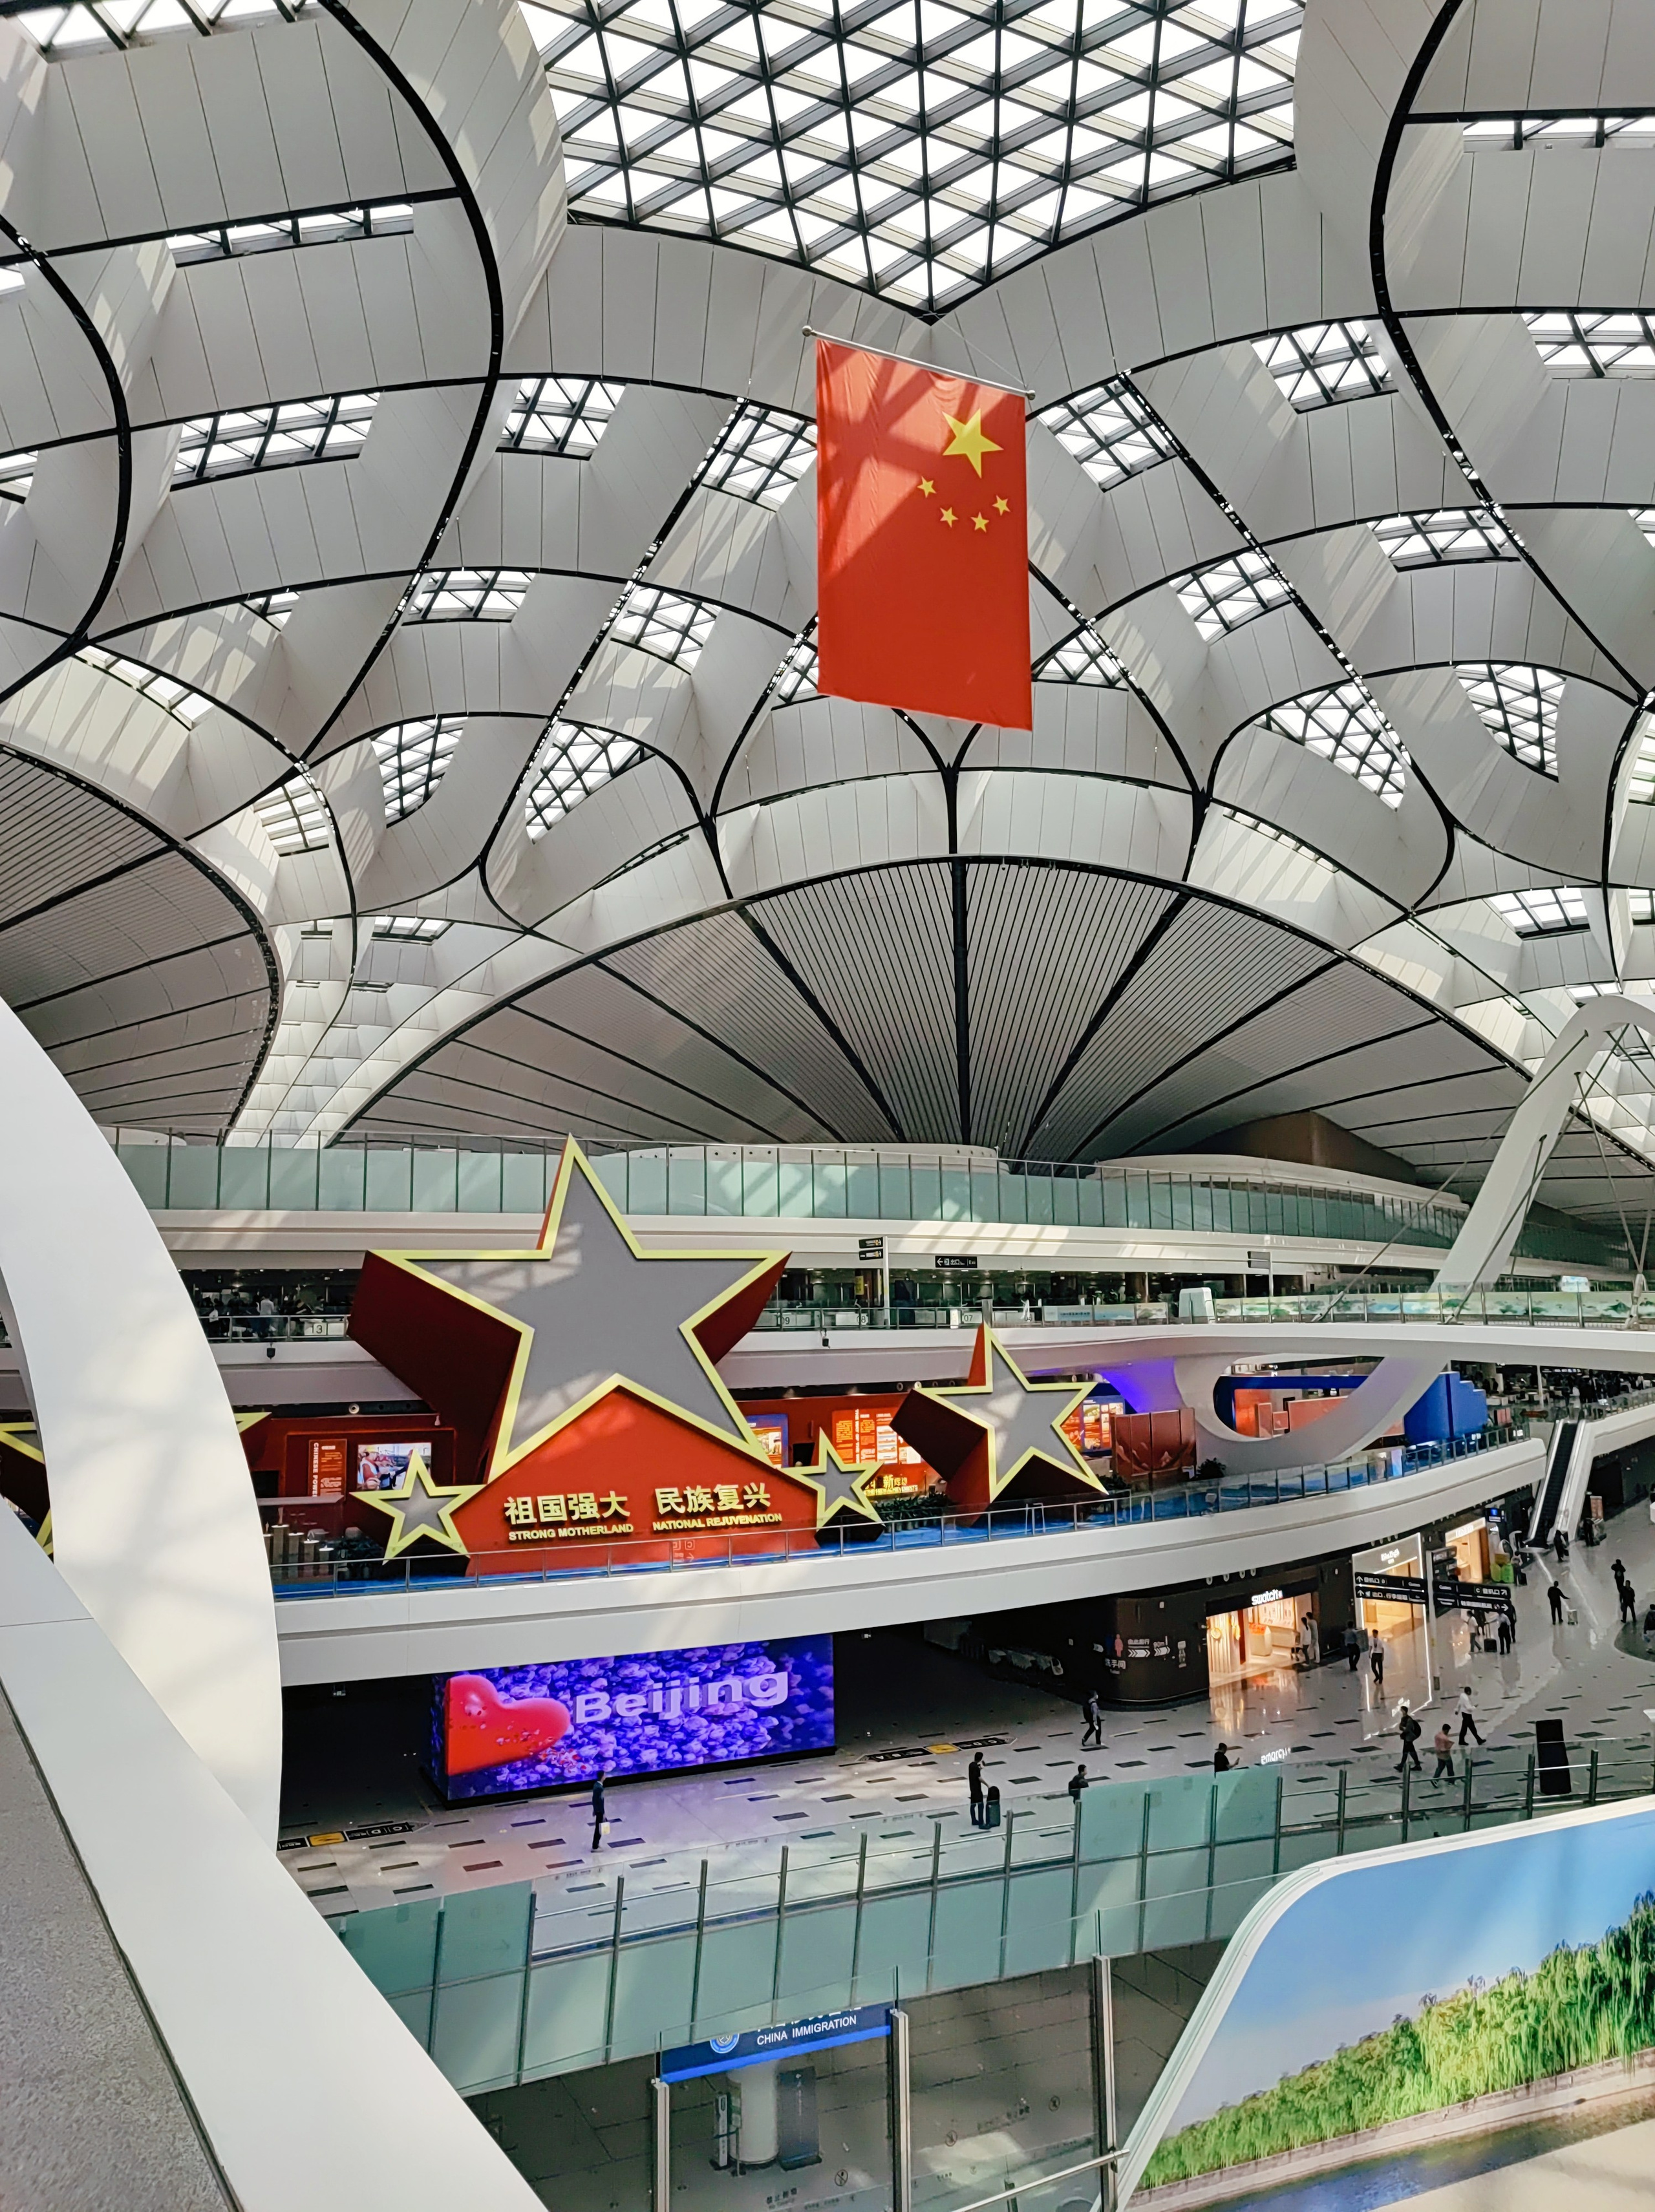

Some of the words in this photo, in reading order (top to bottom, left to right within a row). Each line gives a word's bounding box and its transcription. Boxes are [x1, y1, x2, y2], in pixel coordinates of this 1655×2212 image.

[504, 1491, 630, 1525] 祖国强大
[654, 1482, 771, 1515] 民族复兴
[509, 1528, 556, 1541] STRONG
[558, 1524, 634, 1538] MOTHERLAND
[652, 1518, 705, 1531] NATIONAL
[706, 1513, 783, 1528] REJUVENATION
[1251, 1589, 1279, 1606] swatch
[574, 1671, 788, 1724] Beijing
[757, 2032, 788, 2046] CHINA
[792, 2014, 857, 2038] IMMIGRATION
